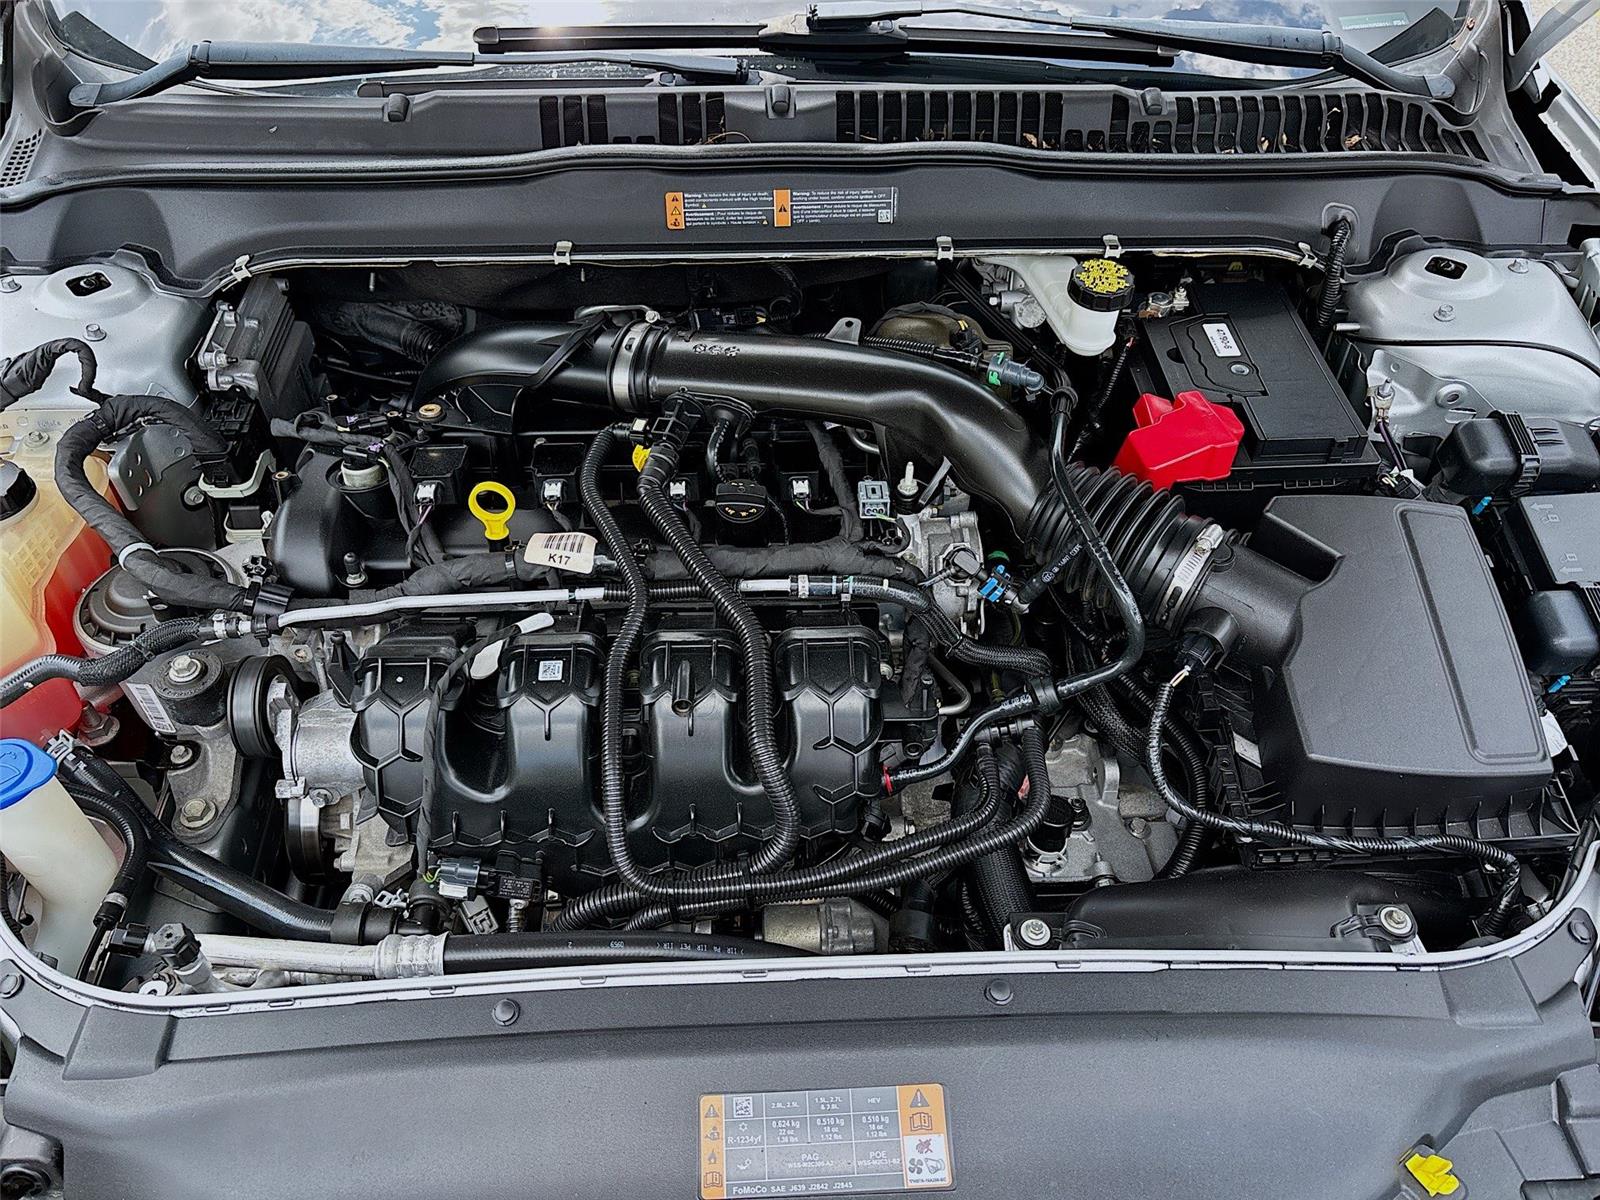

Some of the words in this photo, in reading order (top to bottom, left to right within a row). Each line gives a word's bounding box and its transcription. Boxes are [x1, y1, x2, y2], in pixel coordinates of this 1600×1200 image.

[548, 553, 571, 566] K17
[836, 1118, 844, 1126] kg
[880, 1115, 889, 1123] kg
[727, 1135, 762, 1144] R-1234yf
[733, 1185, 767, 1194] FoMoCo
